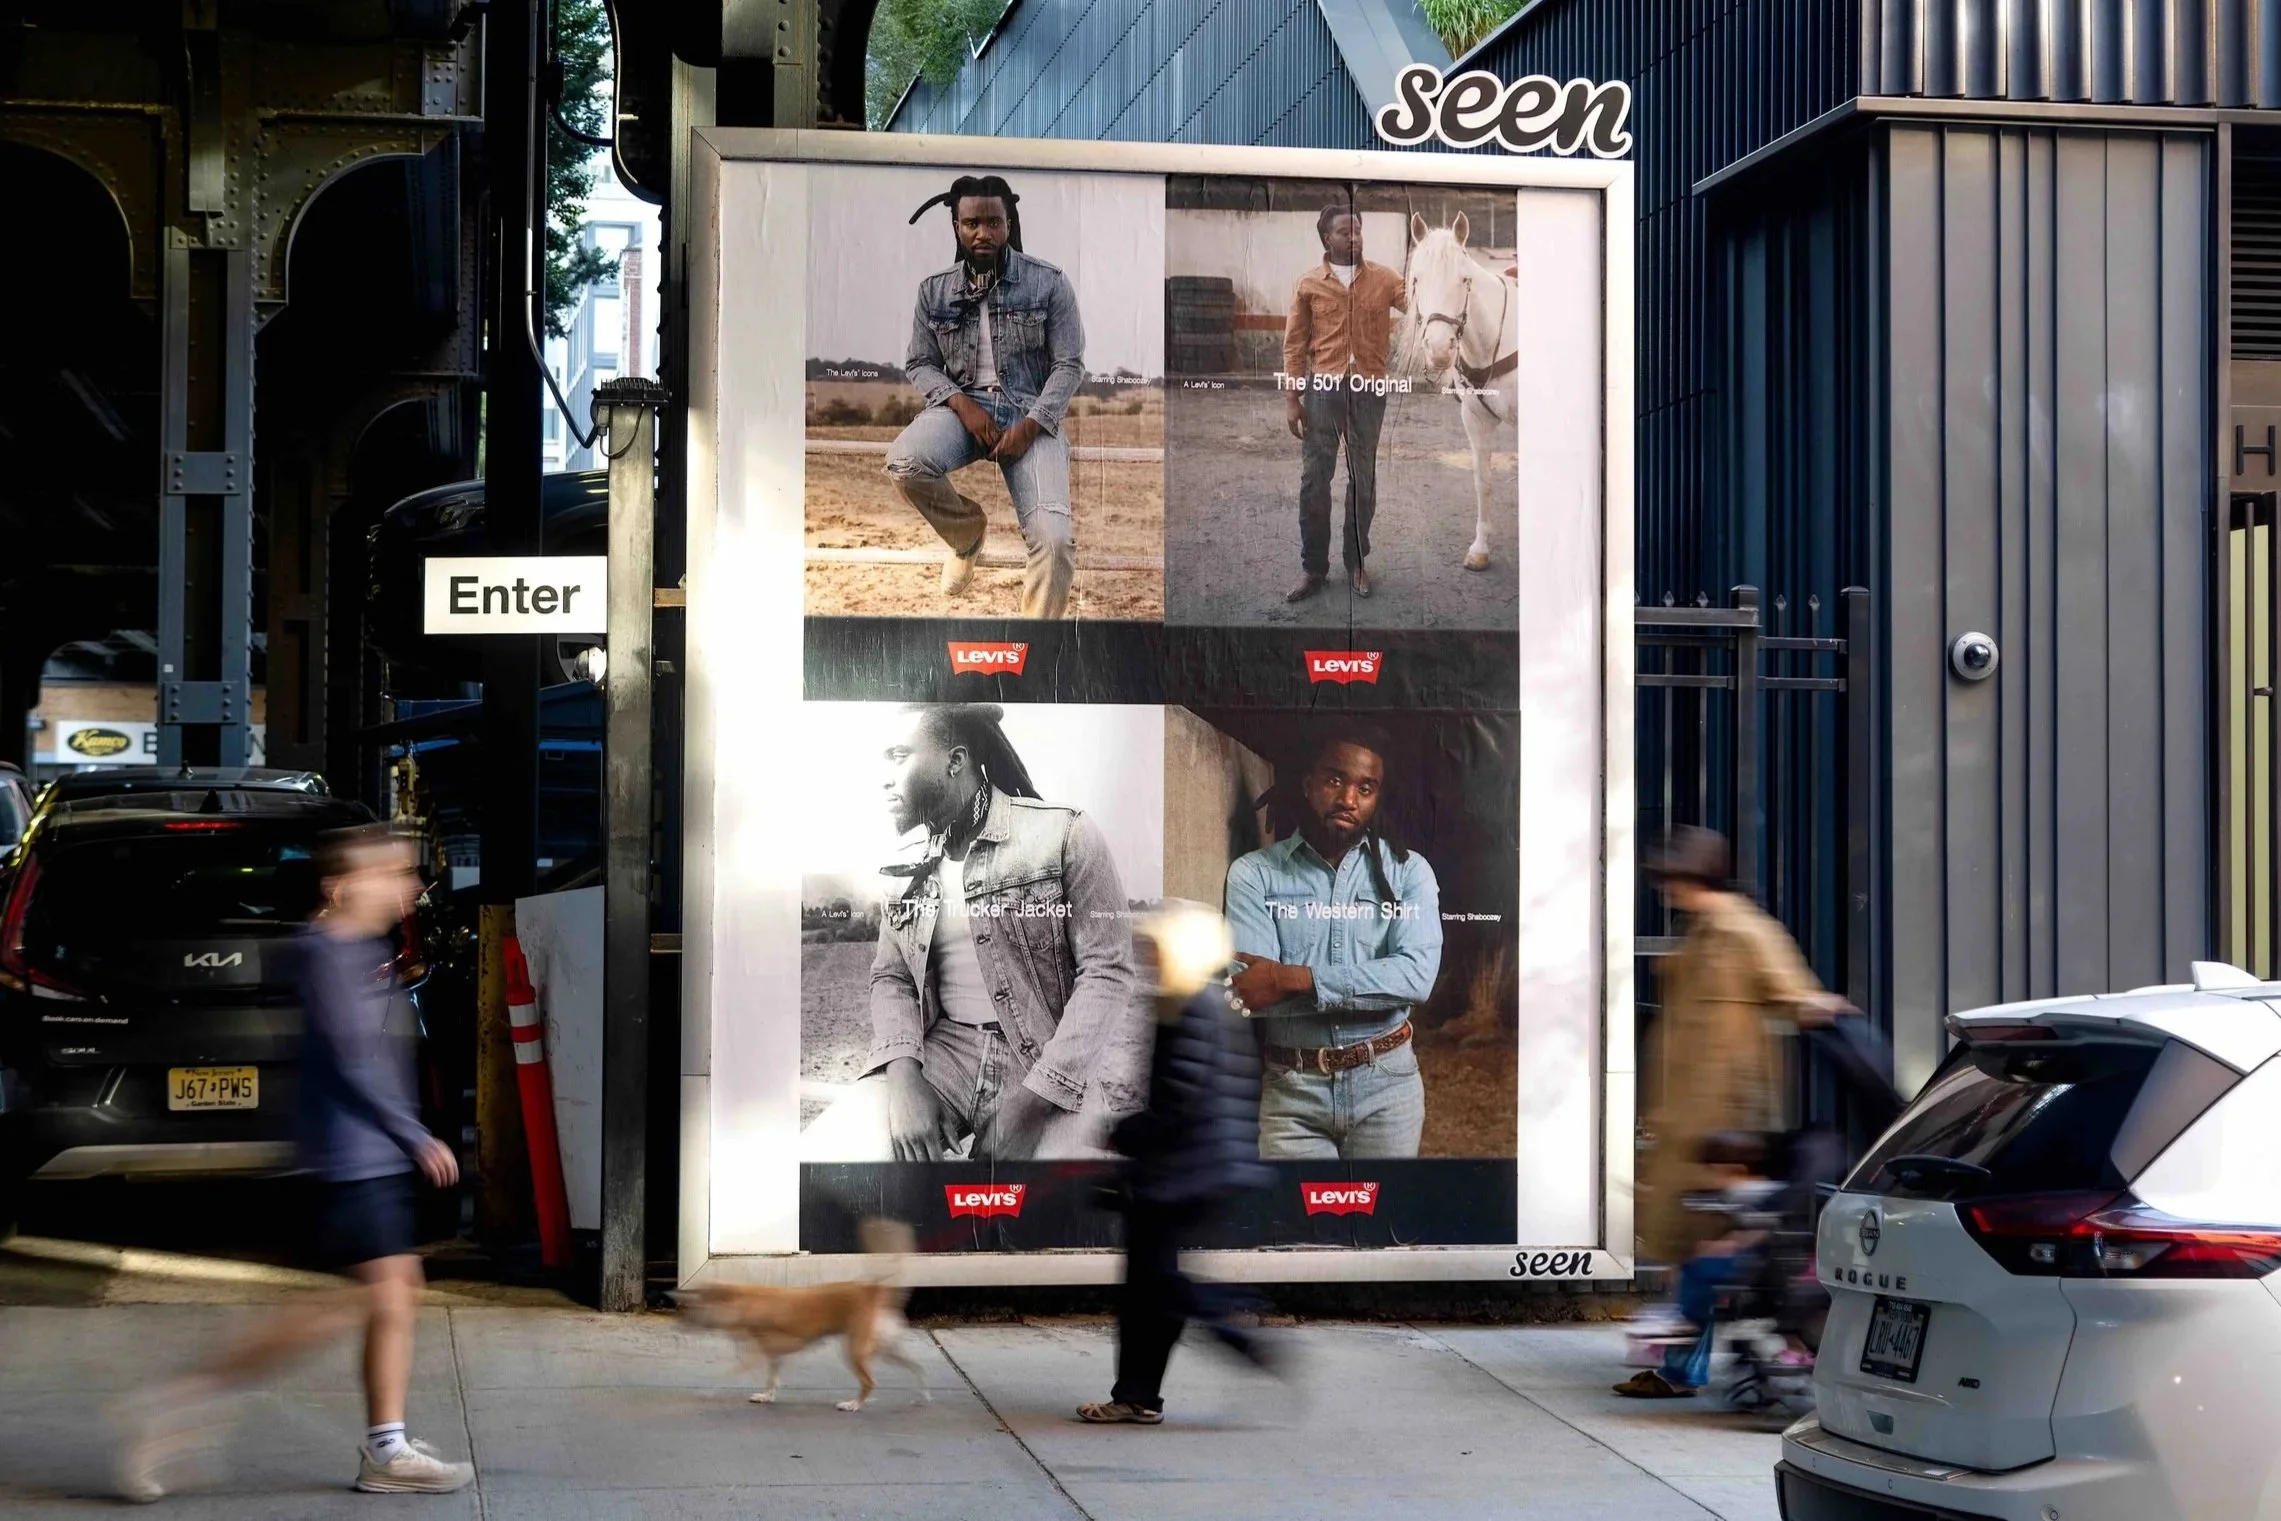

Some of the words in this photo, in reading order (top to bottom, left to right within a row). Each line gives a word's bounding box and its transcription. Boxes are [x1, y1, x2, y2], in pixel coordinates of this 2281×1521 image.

[1378, 66, 1630, 155] seen
[826, 368, 839, 377] The
[861, 369, 879, 378] Icons
[1091, 375, 1115, 385] Starring
[1183, 380, 1190, 388] A
[1211, 380, 1225, 389] Icon
[1273, 372, 1307, 391] The
[1349, 374, 1412, 397] Original
[2235, 425, 2276, 476] H
[449, 575, 581, 614] Enter
[821, 910, 828, 918] A
[901, 899, 936, 917] The
[944, 899, 1006, 918] Trucker
[1014, 899, 1073, 918] Jacket
[1090, 910, 1115, 920] Starring
[1265, 901, 1298, 920] The
[1305, 901, 1375, 920] Western
[1380, 901, 1420, 920] Shirt
[1441, 912, 1466, 922] Starring
[184, 952, 242, 967] KIA
[1509, 1251, 1593, 1277] seen
[1834, 1267, 1906, 1291] ROGUE
